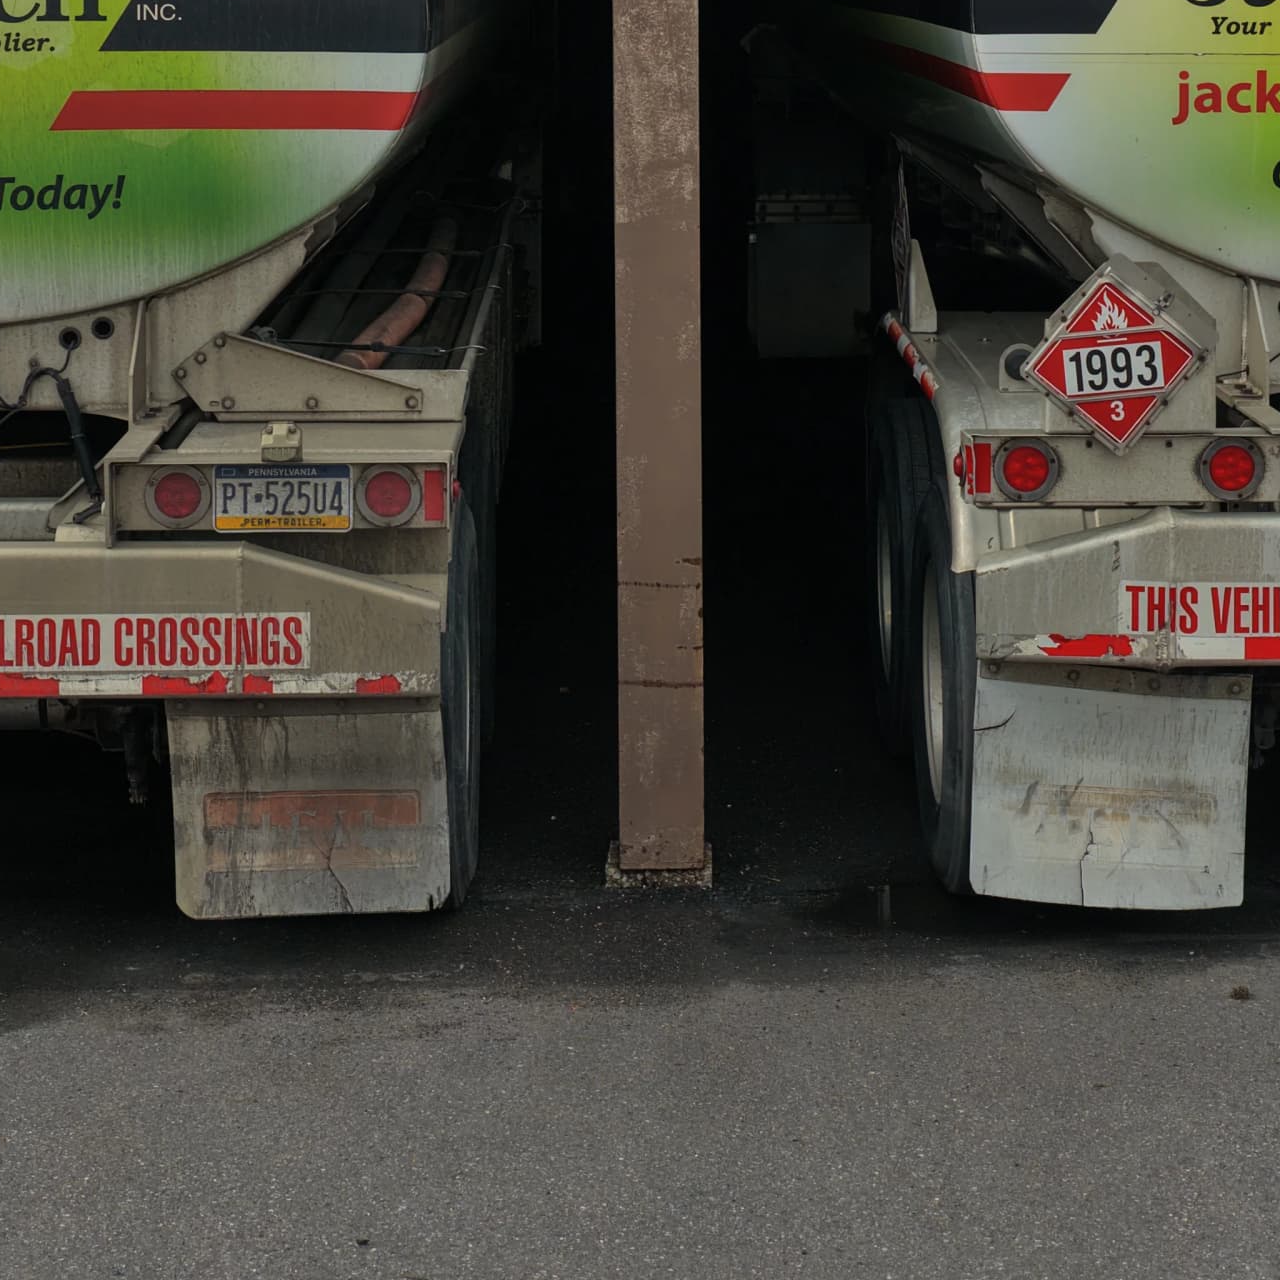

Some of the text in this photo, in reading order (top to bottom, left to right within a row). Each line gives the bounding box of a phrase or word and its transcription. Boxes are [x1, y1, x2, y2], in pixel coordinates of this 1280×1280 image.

[136, 3, 182, 21] INC.
[1210, 16, 1271, 36] Your
[1069, 344, 1158, 392] 1993
[1110, 401, 1125, 421] 3
[248, 468, 318, 476] PENNSYLVANIA
[1126, 585, 1198, 634] THIS
[114, 617, 302, 667] CROSSINGS
